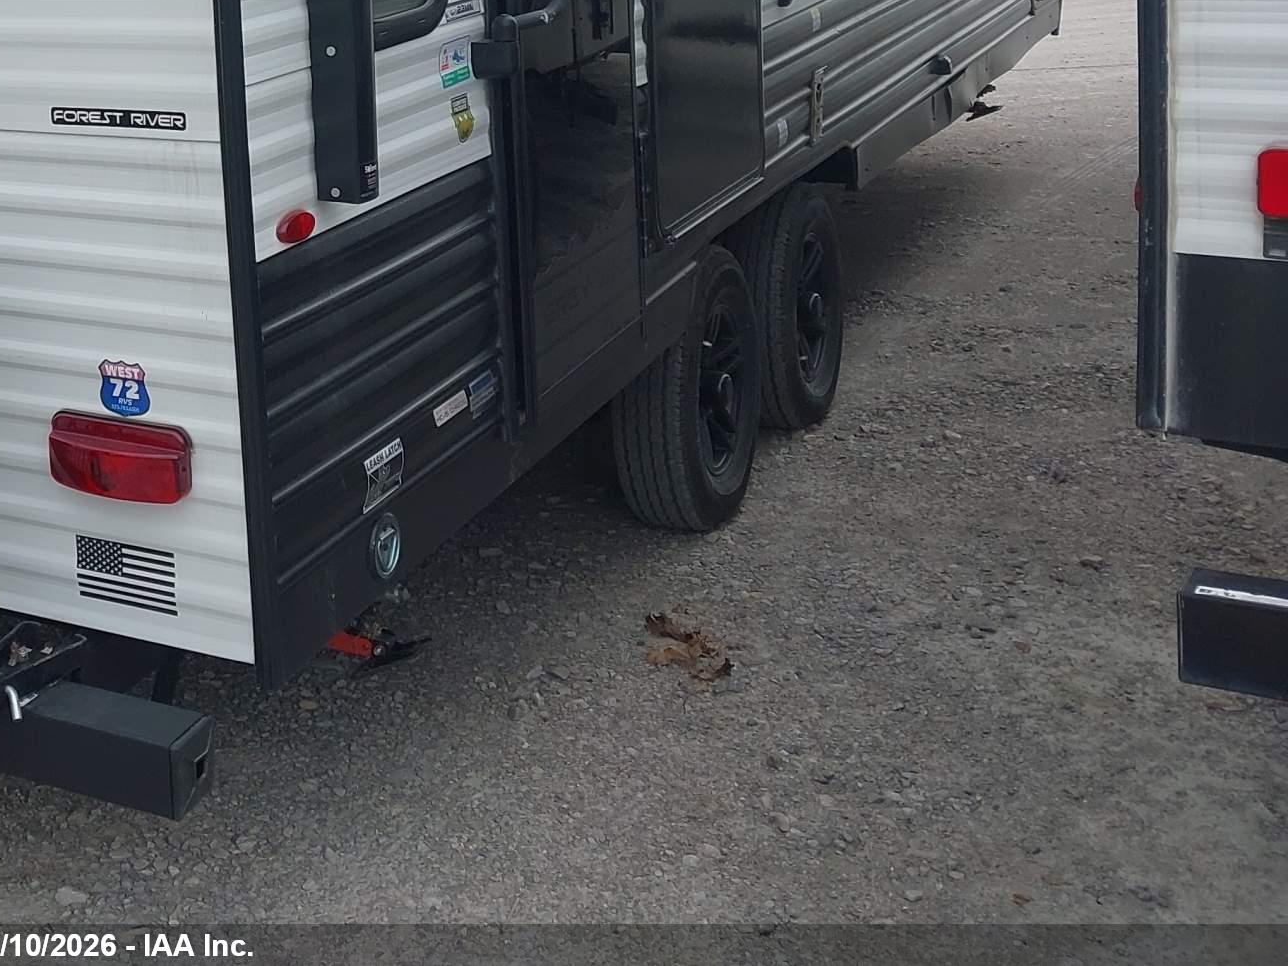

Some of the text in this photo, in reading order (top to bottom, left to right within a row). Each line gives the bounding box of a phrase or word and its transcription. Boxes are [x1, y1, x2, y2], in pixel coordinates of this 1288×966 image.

[53, 110, 184, 128] FOREST RIVER
[105, 365, 140, 380] WEST
[109, 378, 140, 400] 72
[366, 441, 402, 472] LEASH LATCH
